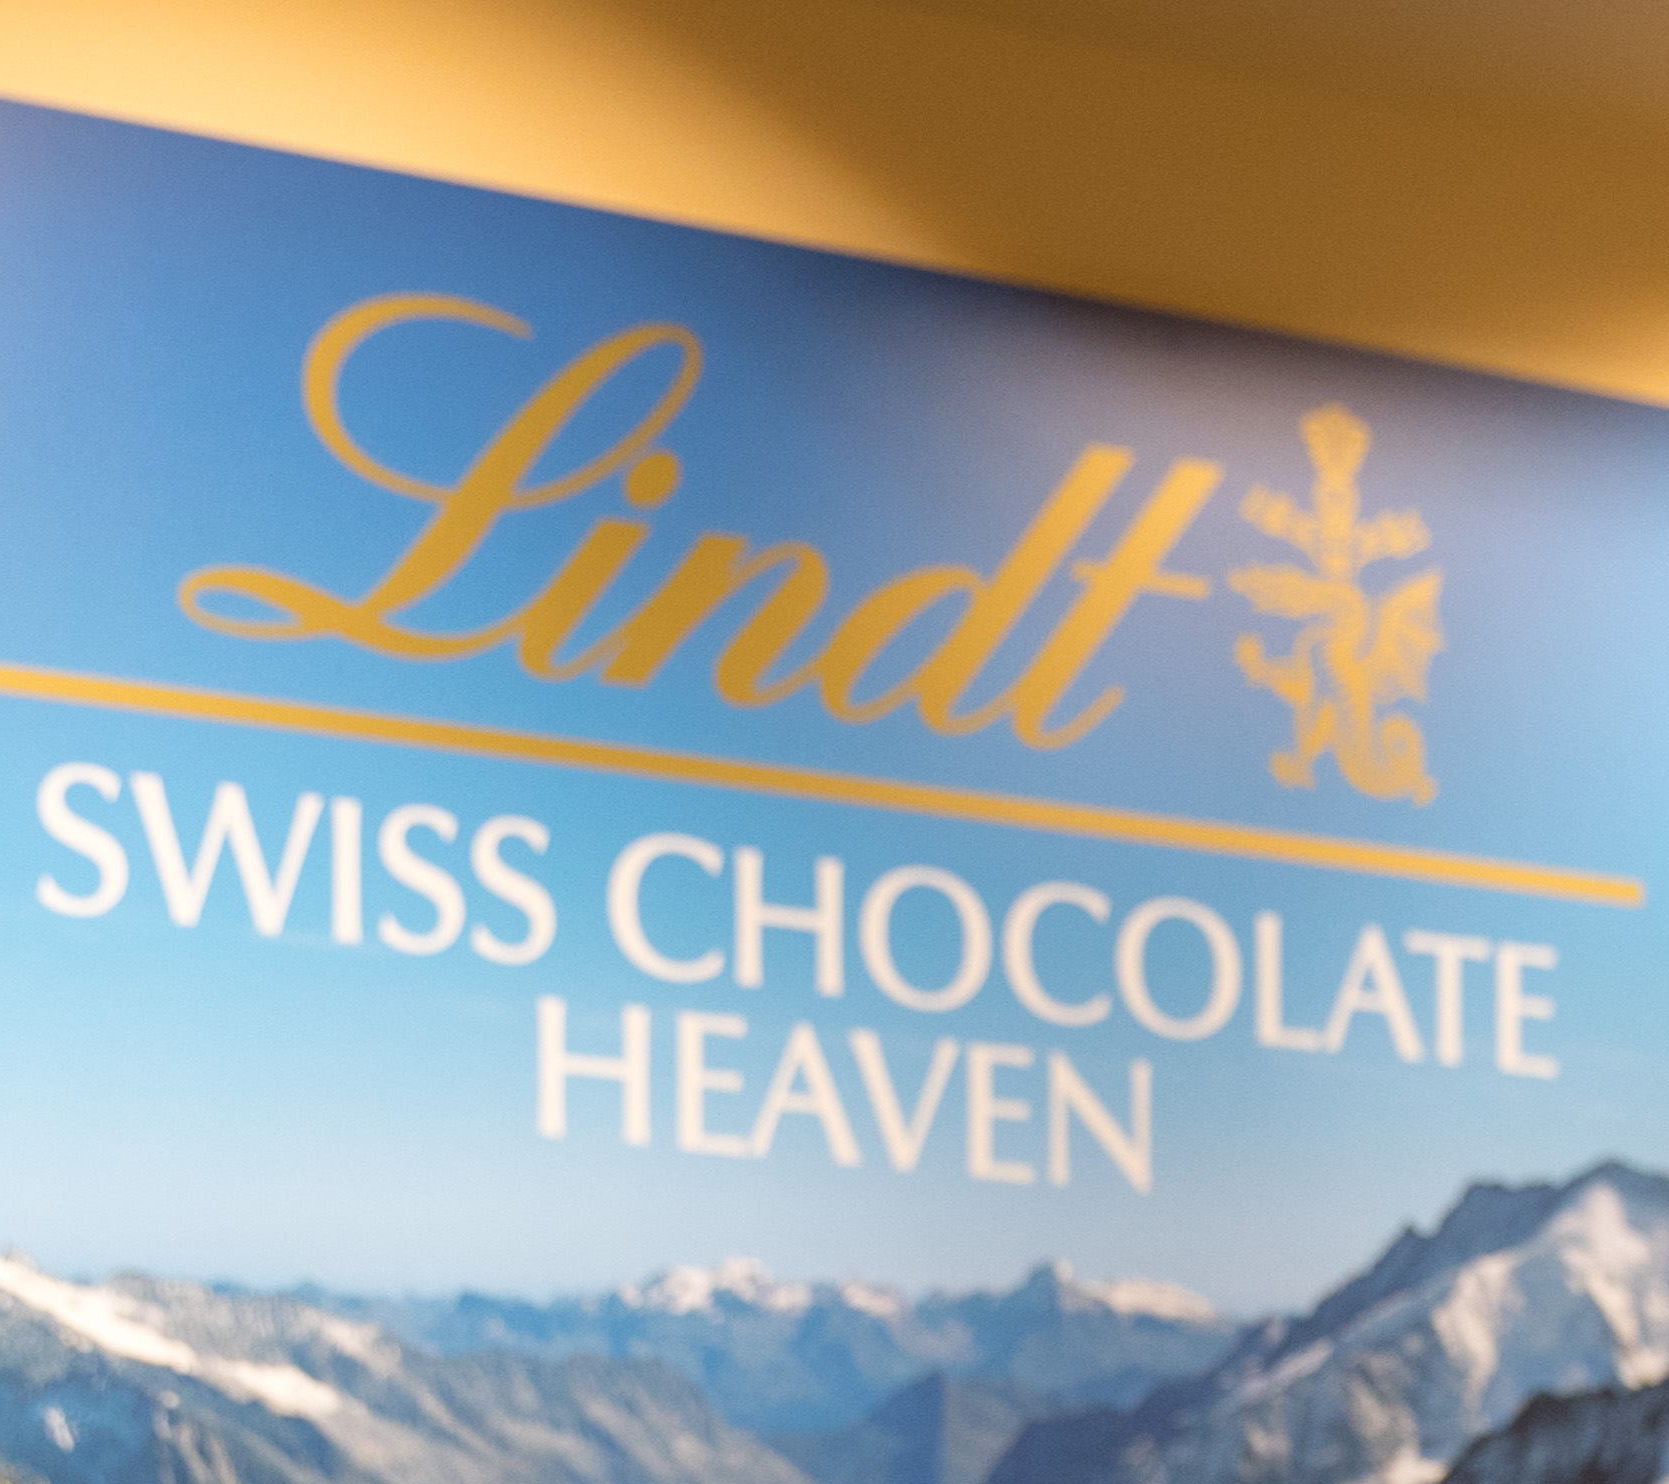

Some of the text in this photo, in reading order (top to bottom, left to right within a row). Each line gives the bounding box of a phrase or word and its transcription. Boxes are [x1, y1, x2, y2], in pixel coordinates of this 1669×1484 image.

[177, 294, 1226, 751] Lindt
[34, 760, 1563, 1082] SWISS CHOCOLATE
[533, 994, 1154, 1195] HEAVEN
